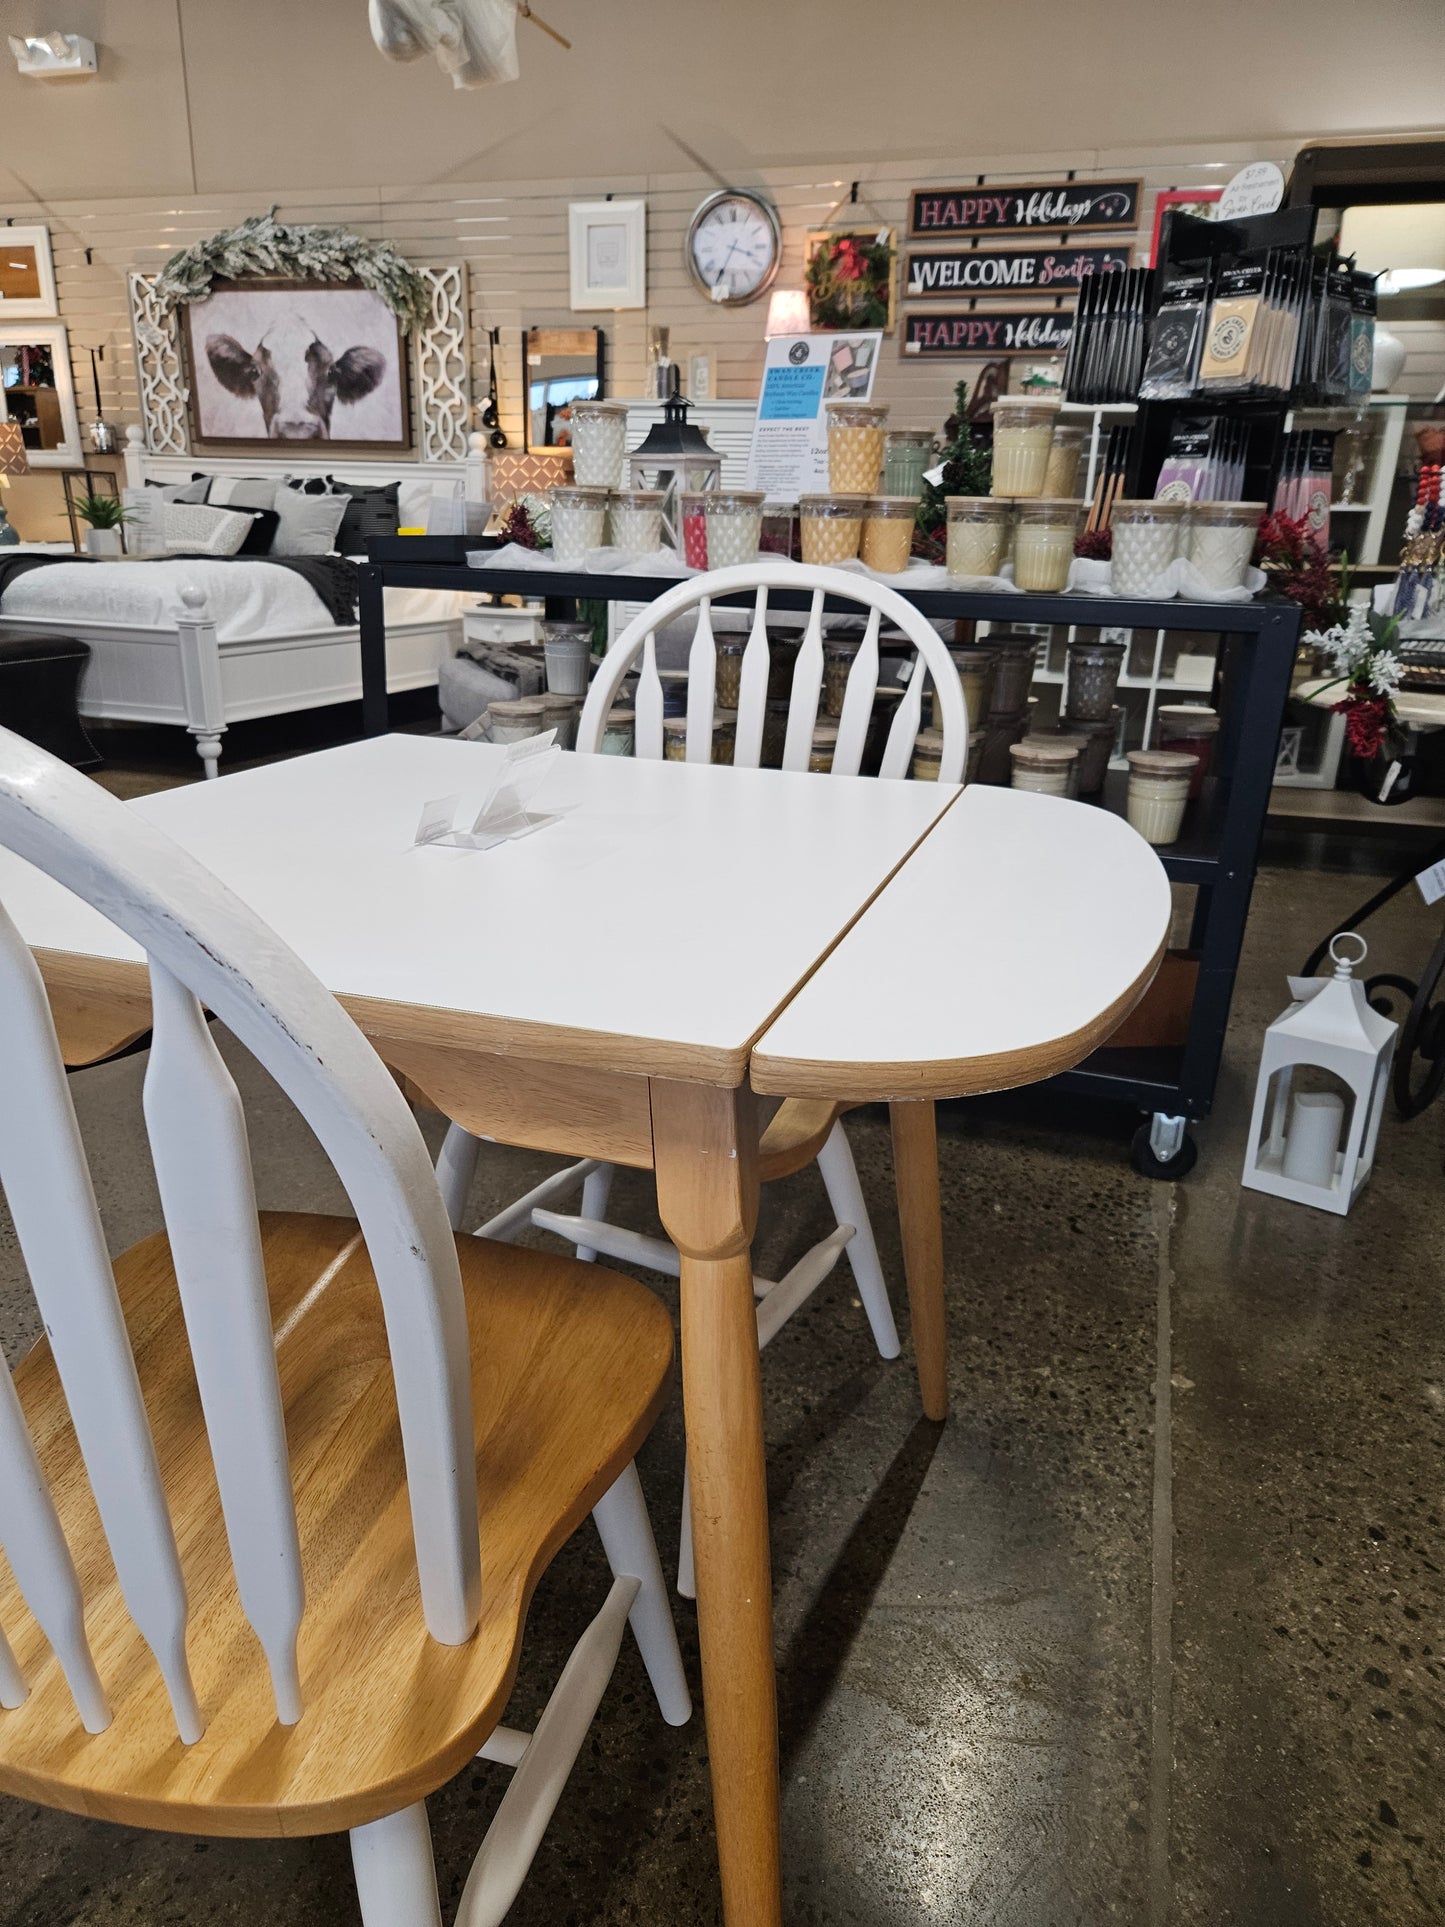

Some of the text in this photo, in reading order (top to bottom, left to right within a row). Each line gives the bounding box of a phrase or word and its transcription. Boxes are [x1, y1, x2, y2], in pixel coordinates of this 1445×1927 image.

[920, 191, 1092, 226] HAPPY Holidays
[912, 255, 1096, 287] WELCOME Santa
[913, 317, 1073, 349] HAPPY Holiday
